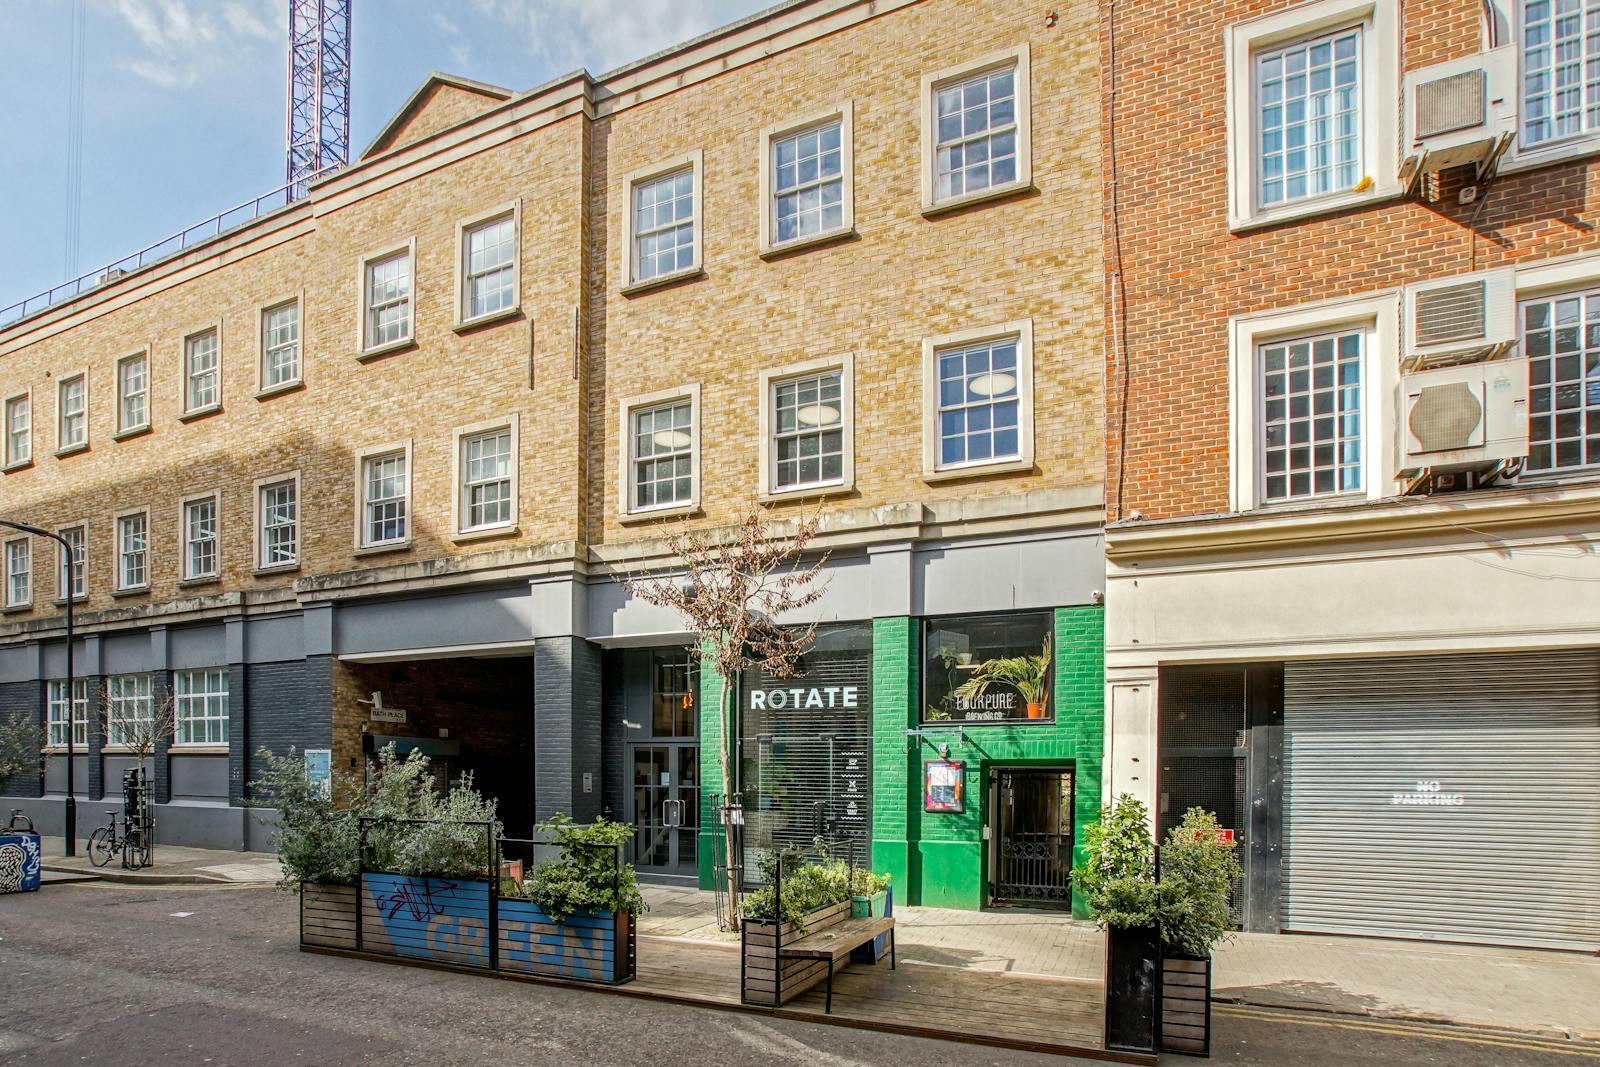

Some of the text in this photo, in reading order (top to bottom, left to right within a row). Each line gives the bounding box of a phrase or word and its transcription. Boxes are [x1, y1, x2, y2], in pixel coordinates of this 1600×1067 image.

[750, 687, 858, 710] ROTATE
[1416, 780, 1441, 792] NO
[1392, 793, 1464, 806] PARKING
[426, 914, 604, 981] GREEN
